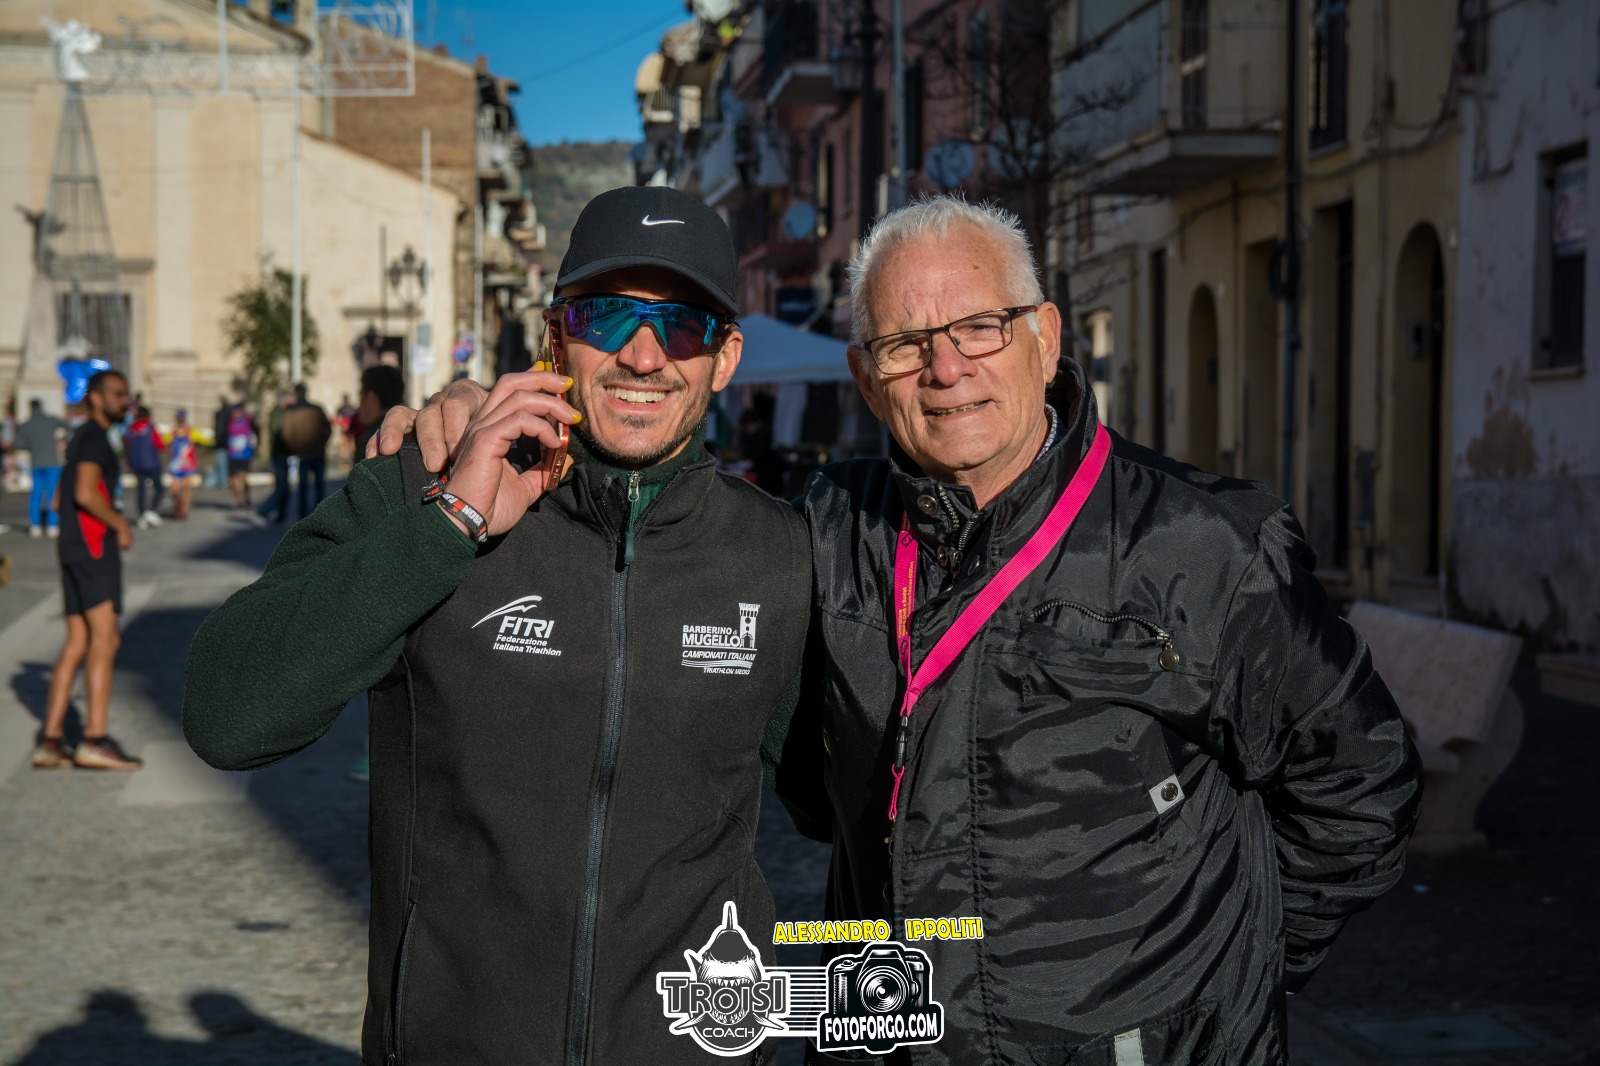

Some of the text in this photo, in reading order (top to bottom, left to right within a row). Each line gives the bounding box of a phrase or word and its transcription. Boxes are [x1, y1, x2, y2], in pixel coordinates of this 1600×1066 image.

[499, 615, 555, 639] FITRI
[682, 625, 733, 635] BARBERINO
[496, 634, 548, 647] Federazione
[682, 632, 741, 648] MUGELLO
[493, 642, 562, 657] Italiana Triathlon
[682, 650, 727, 660] CAMPIONATI
